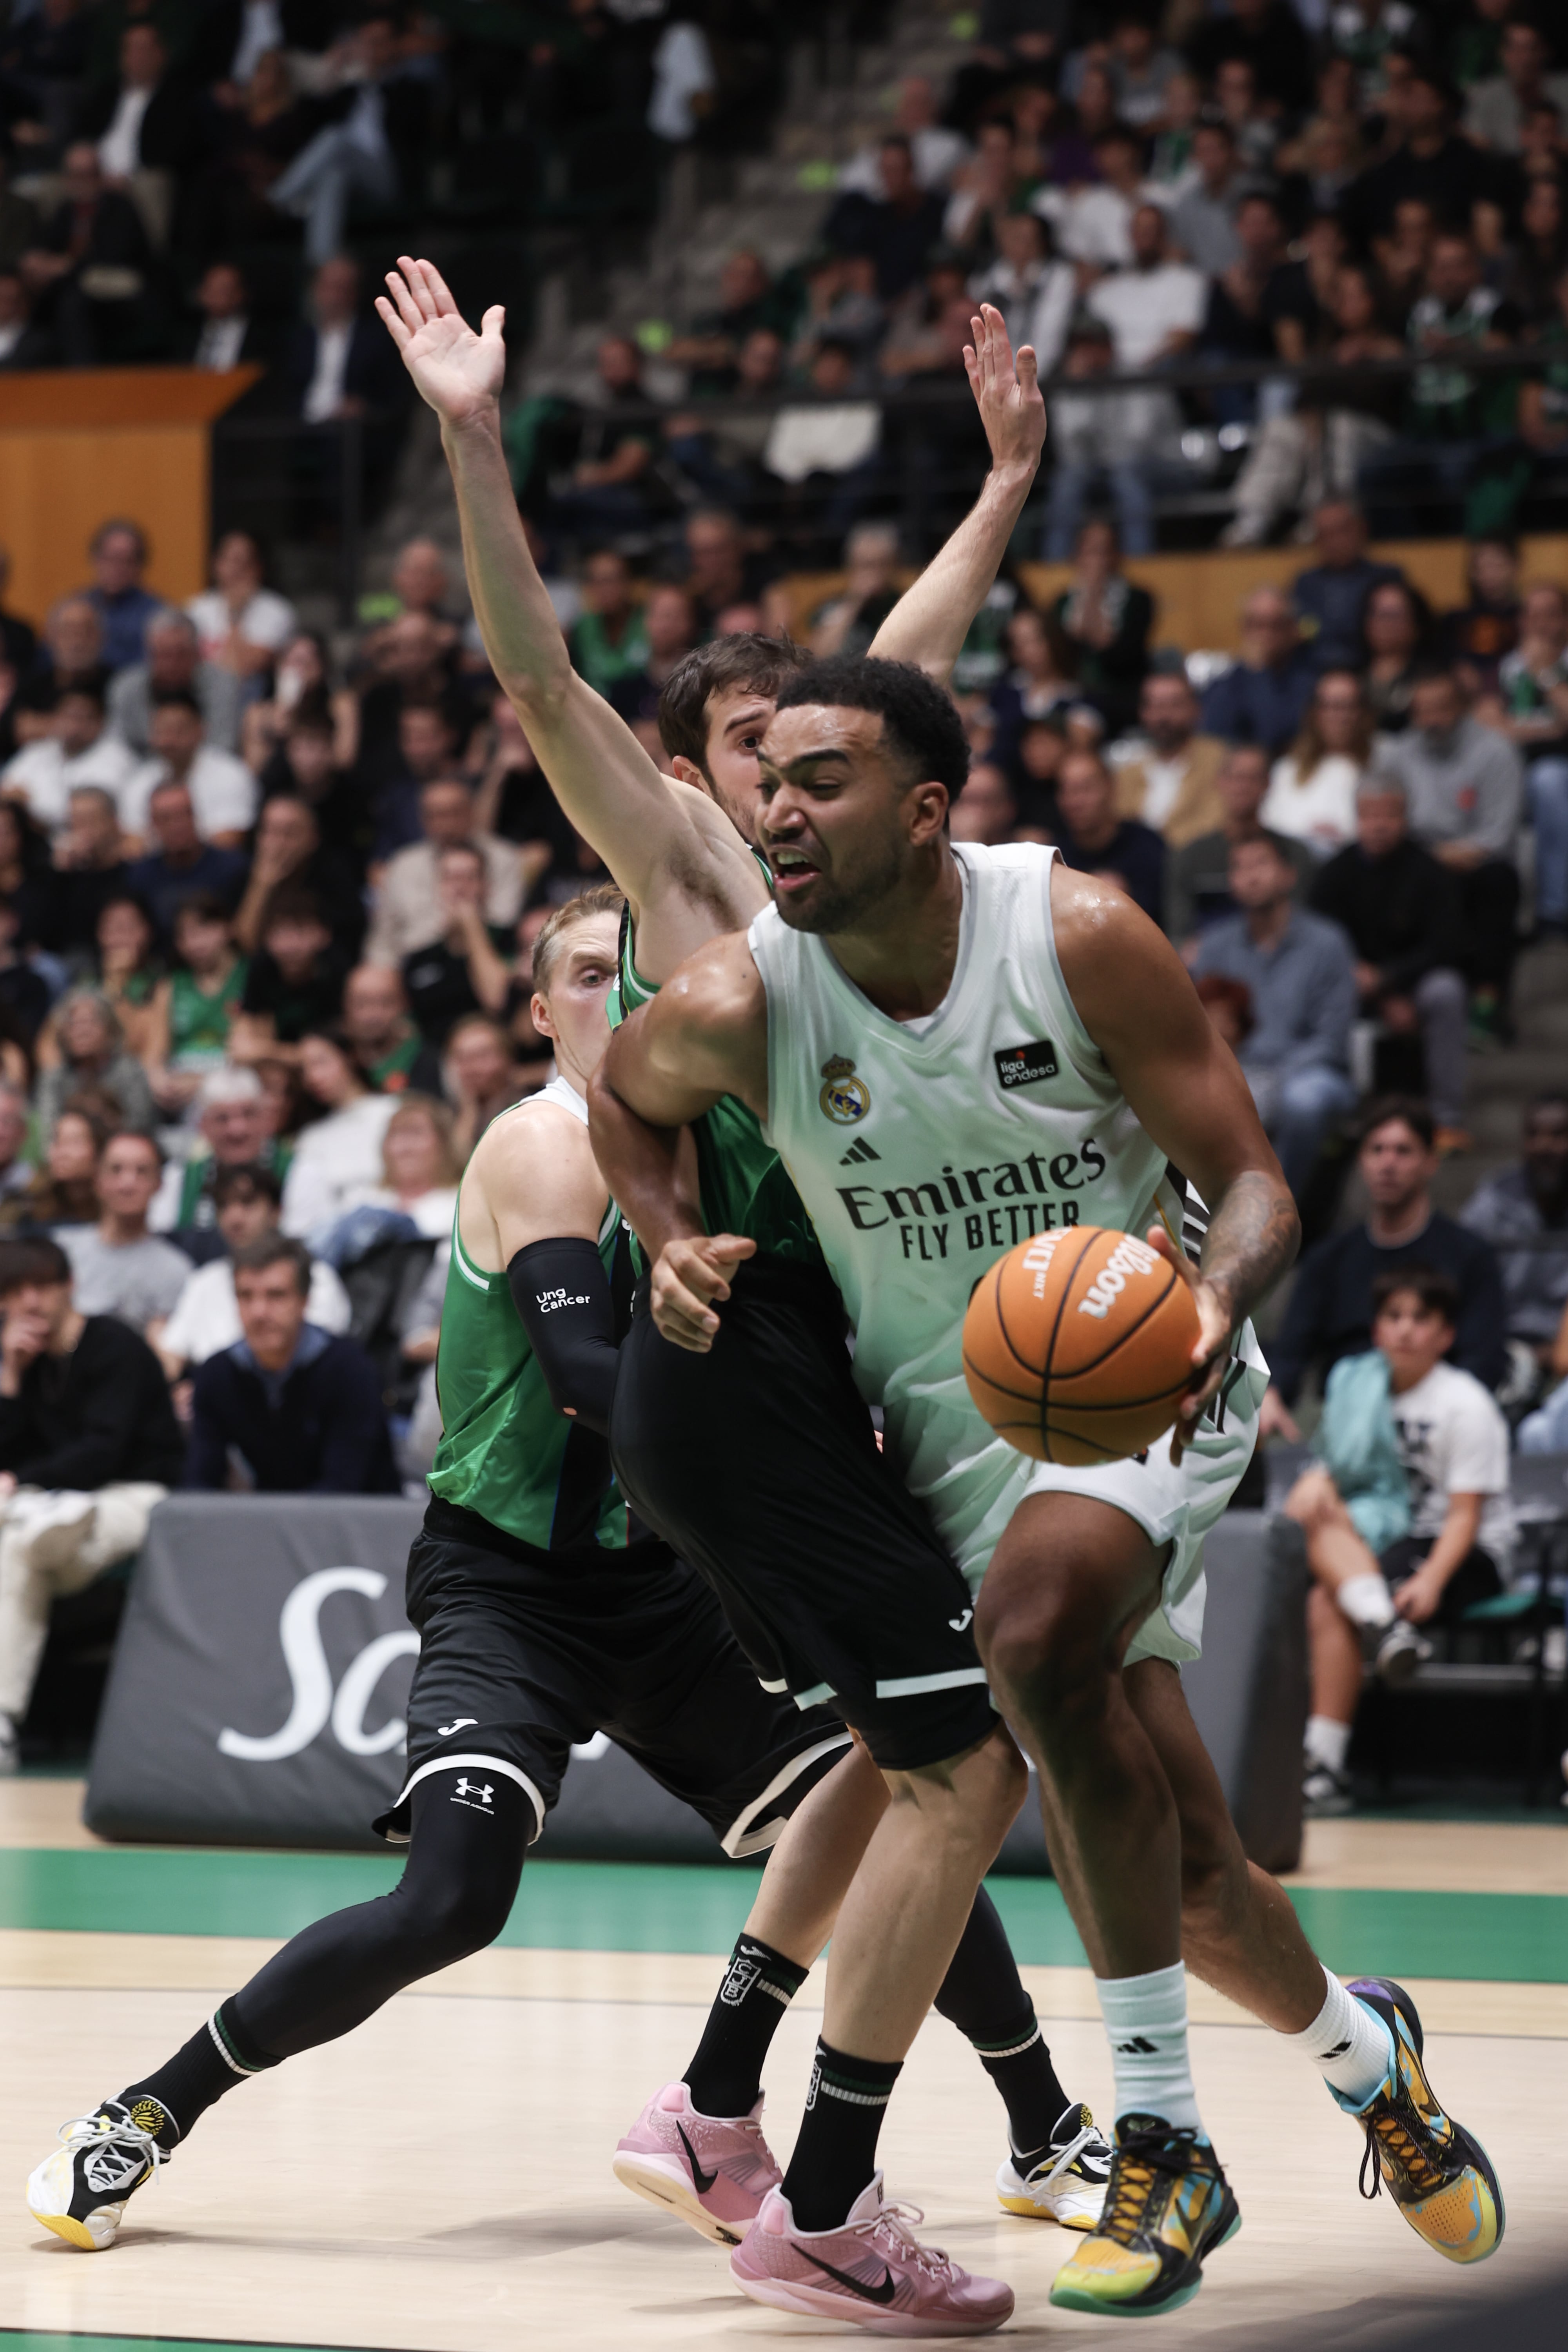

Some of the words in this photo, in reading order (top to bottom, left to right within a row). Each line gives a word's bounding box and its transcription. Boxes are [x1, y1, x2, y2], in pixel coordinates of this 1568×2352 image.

[1000, 1060, 1025, 1074] liga
[1004, 1064, 1054, 1084] endesa
[835, 1138, 1106, 1230] Emirates
[900, 1224, 949, 1260] FLY
[964, 1201, 1079, 1250] BETTER
[536, 1288, 566, 1304] Ung
[540, 1296, 590, 1313] Cancer
